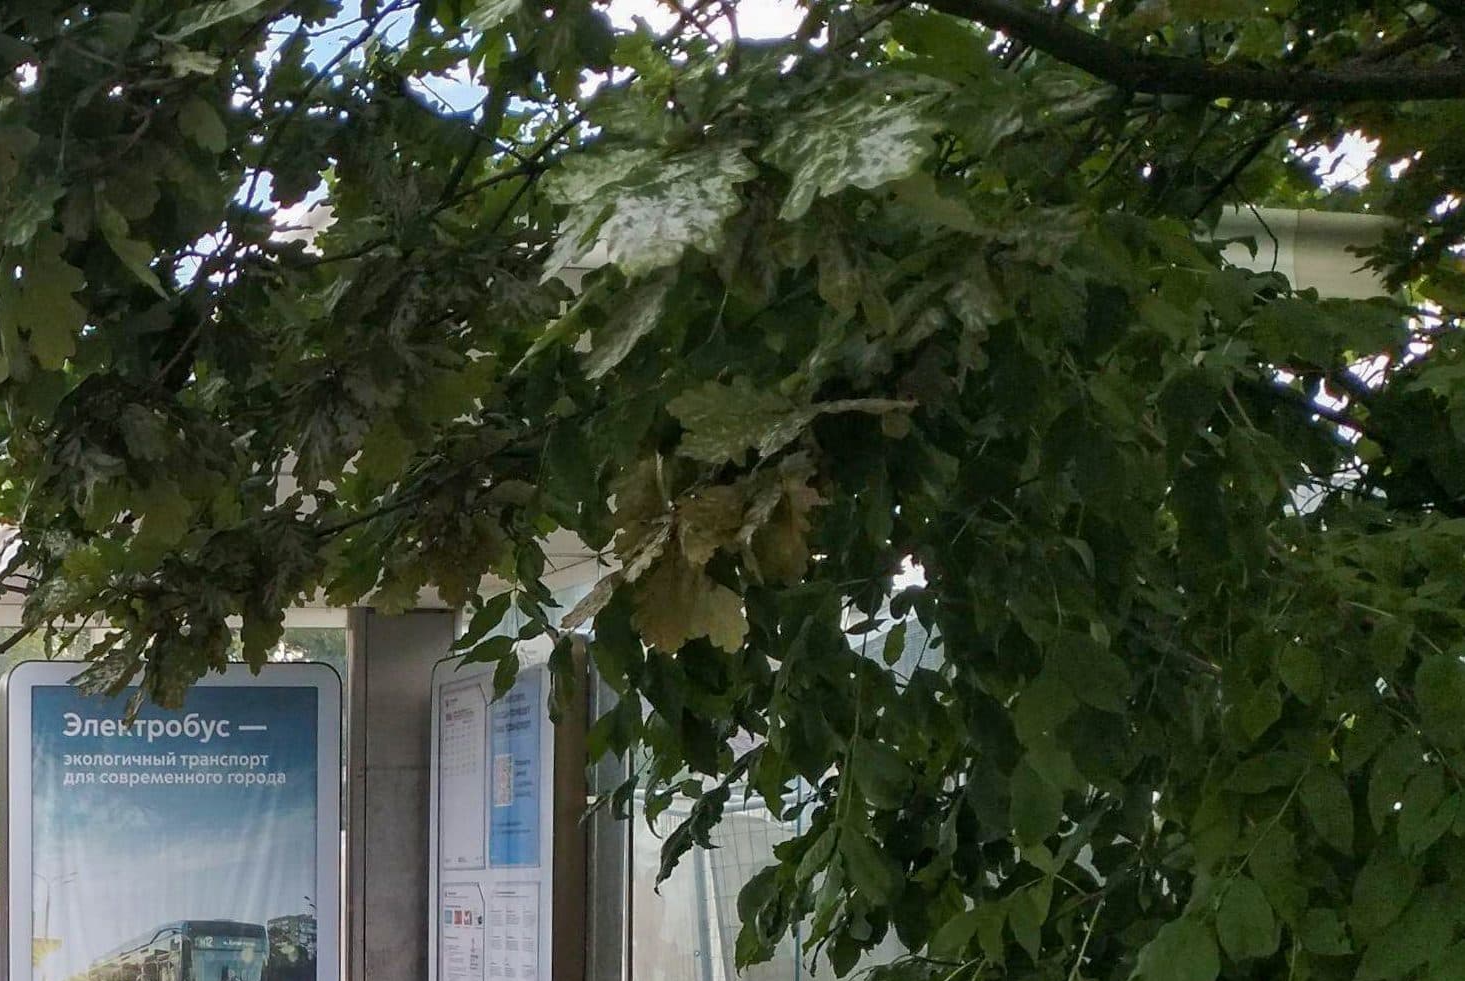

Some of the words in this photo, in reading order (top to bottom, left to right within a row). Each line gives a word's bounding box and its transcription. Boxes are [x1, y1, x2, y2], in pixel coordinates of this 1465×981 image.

[62, 712, 231, 743] Электробус
[63, 752, 177, 767] экологичный
[179, 754, 270, 769] транспорт
[62, 772, 95, 787] для
[99, 772, 224, 787] современного
[227, 772, 287, 787] города
